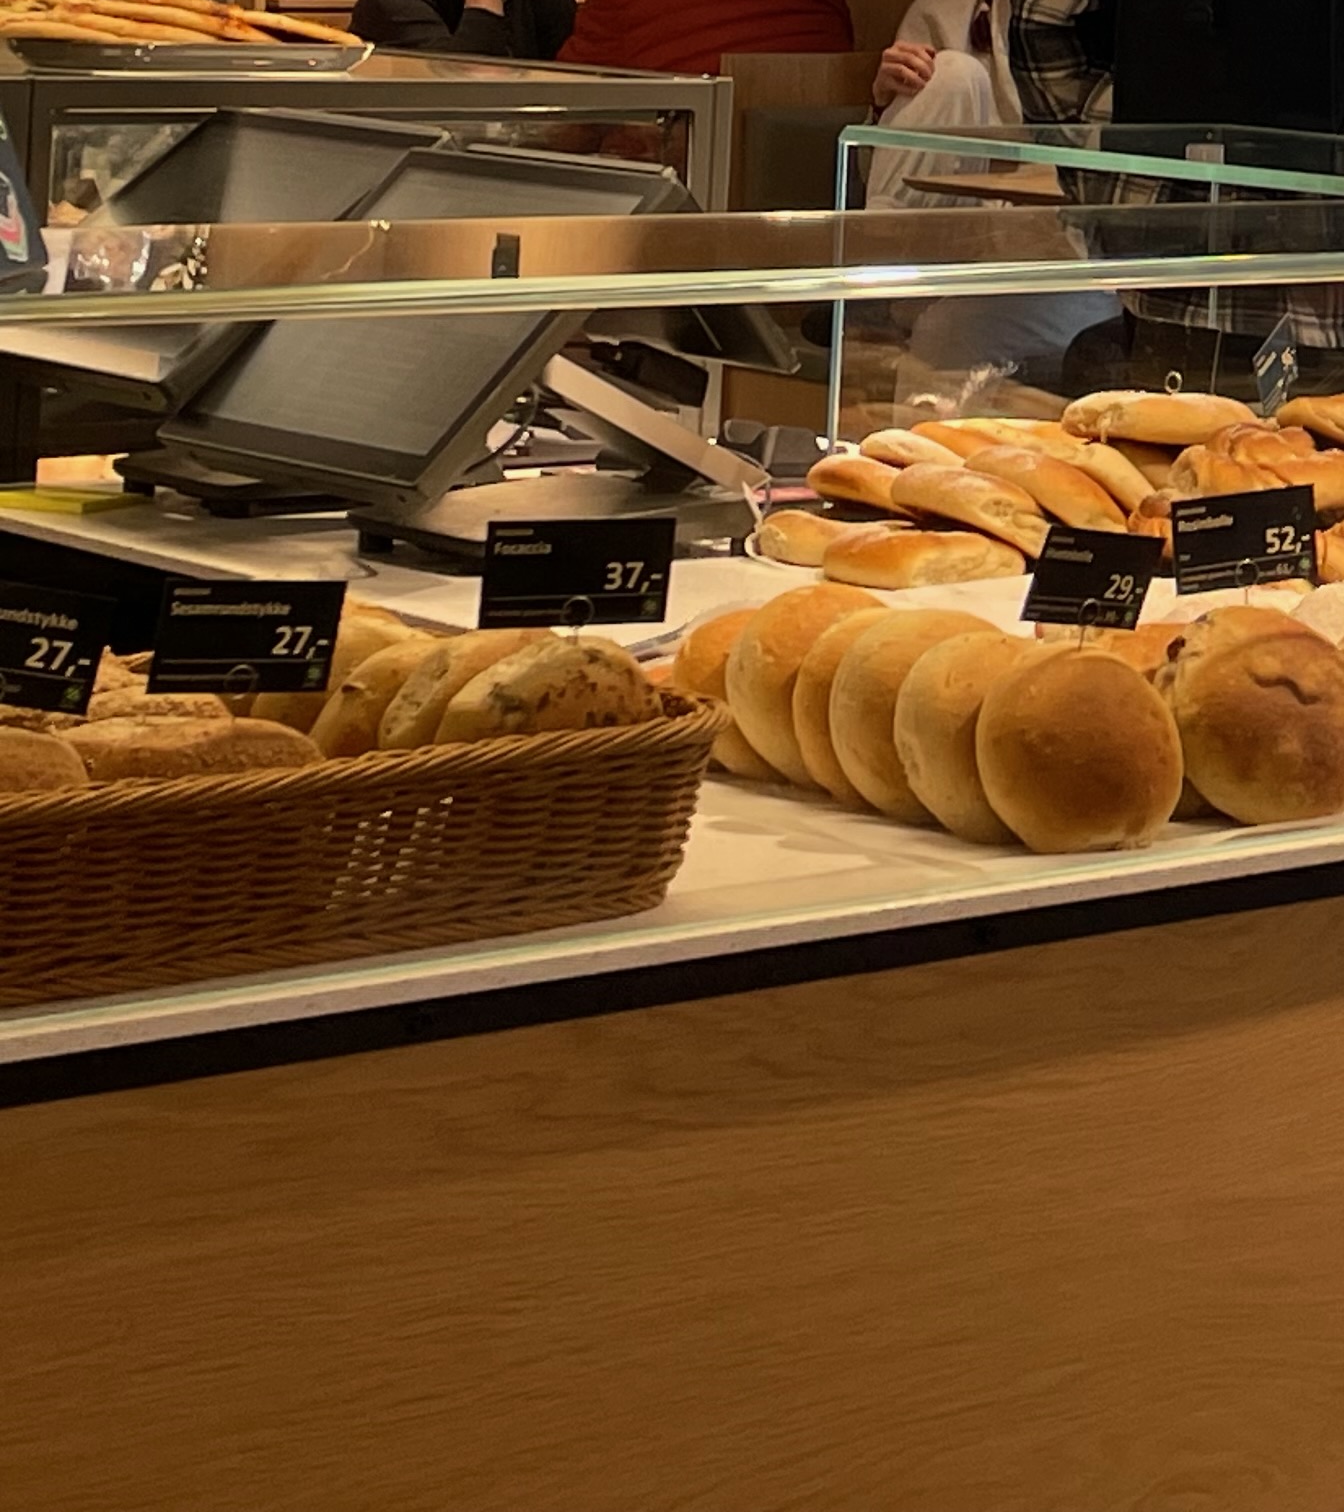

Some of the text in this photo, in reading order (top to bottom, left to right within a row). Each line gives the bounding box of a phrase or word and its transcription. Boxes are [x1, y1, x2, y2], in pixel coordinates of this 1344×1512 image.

[1264, 525, 1311, 556] 52,-
[603, 561, 664, 593] 37,-
[1103, 573, 1145, 605] 29,-
[25, 637, 92, 678] 27,-
[271, 625, 330, 661] 27,-
